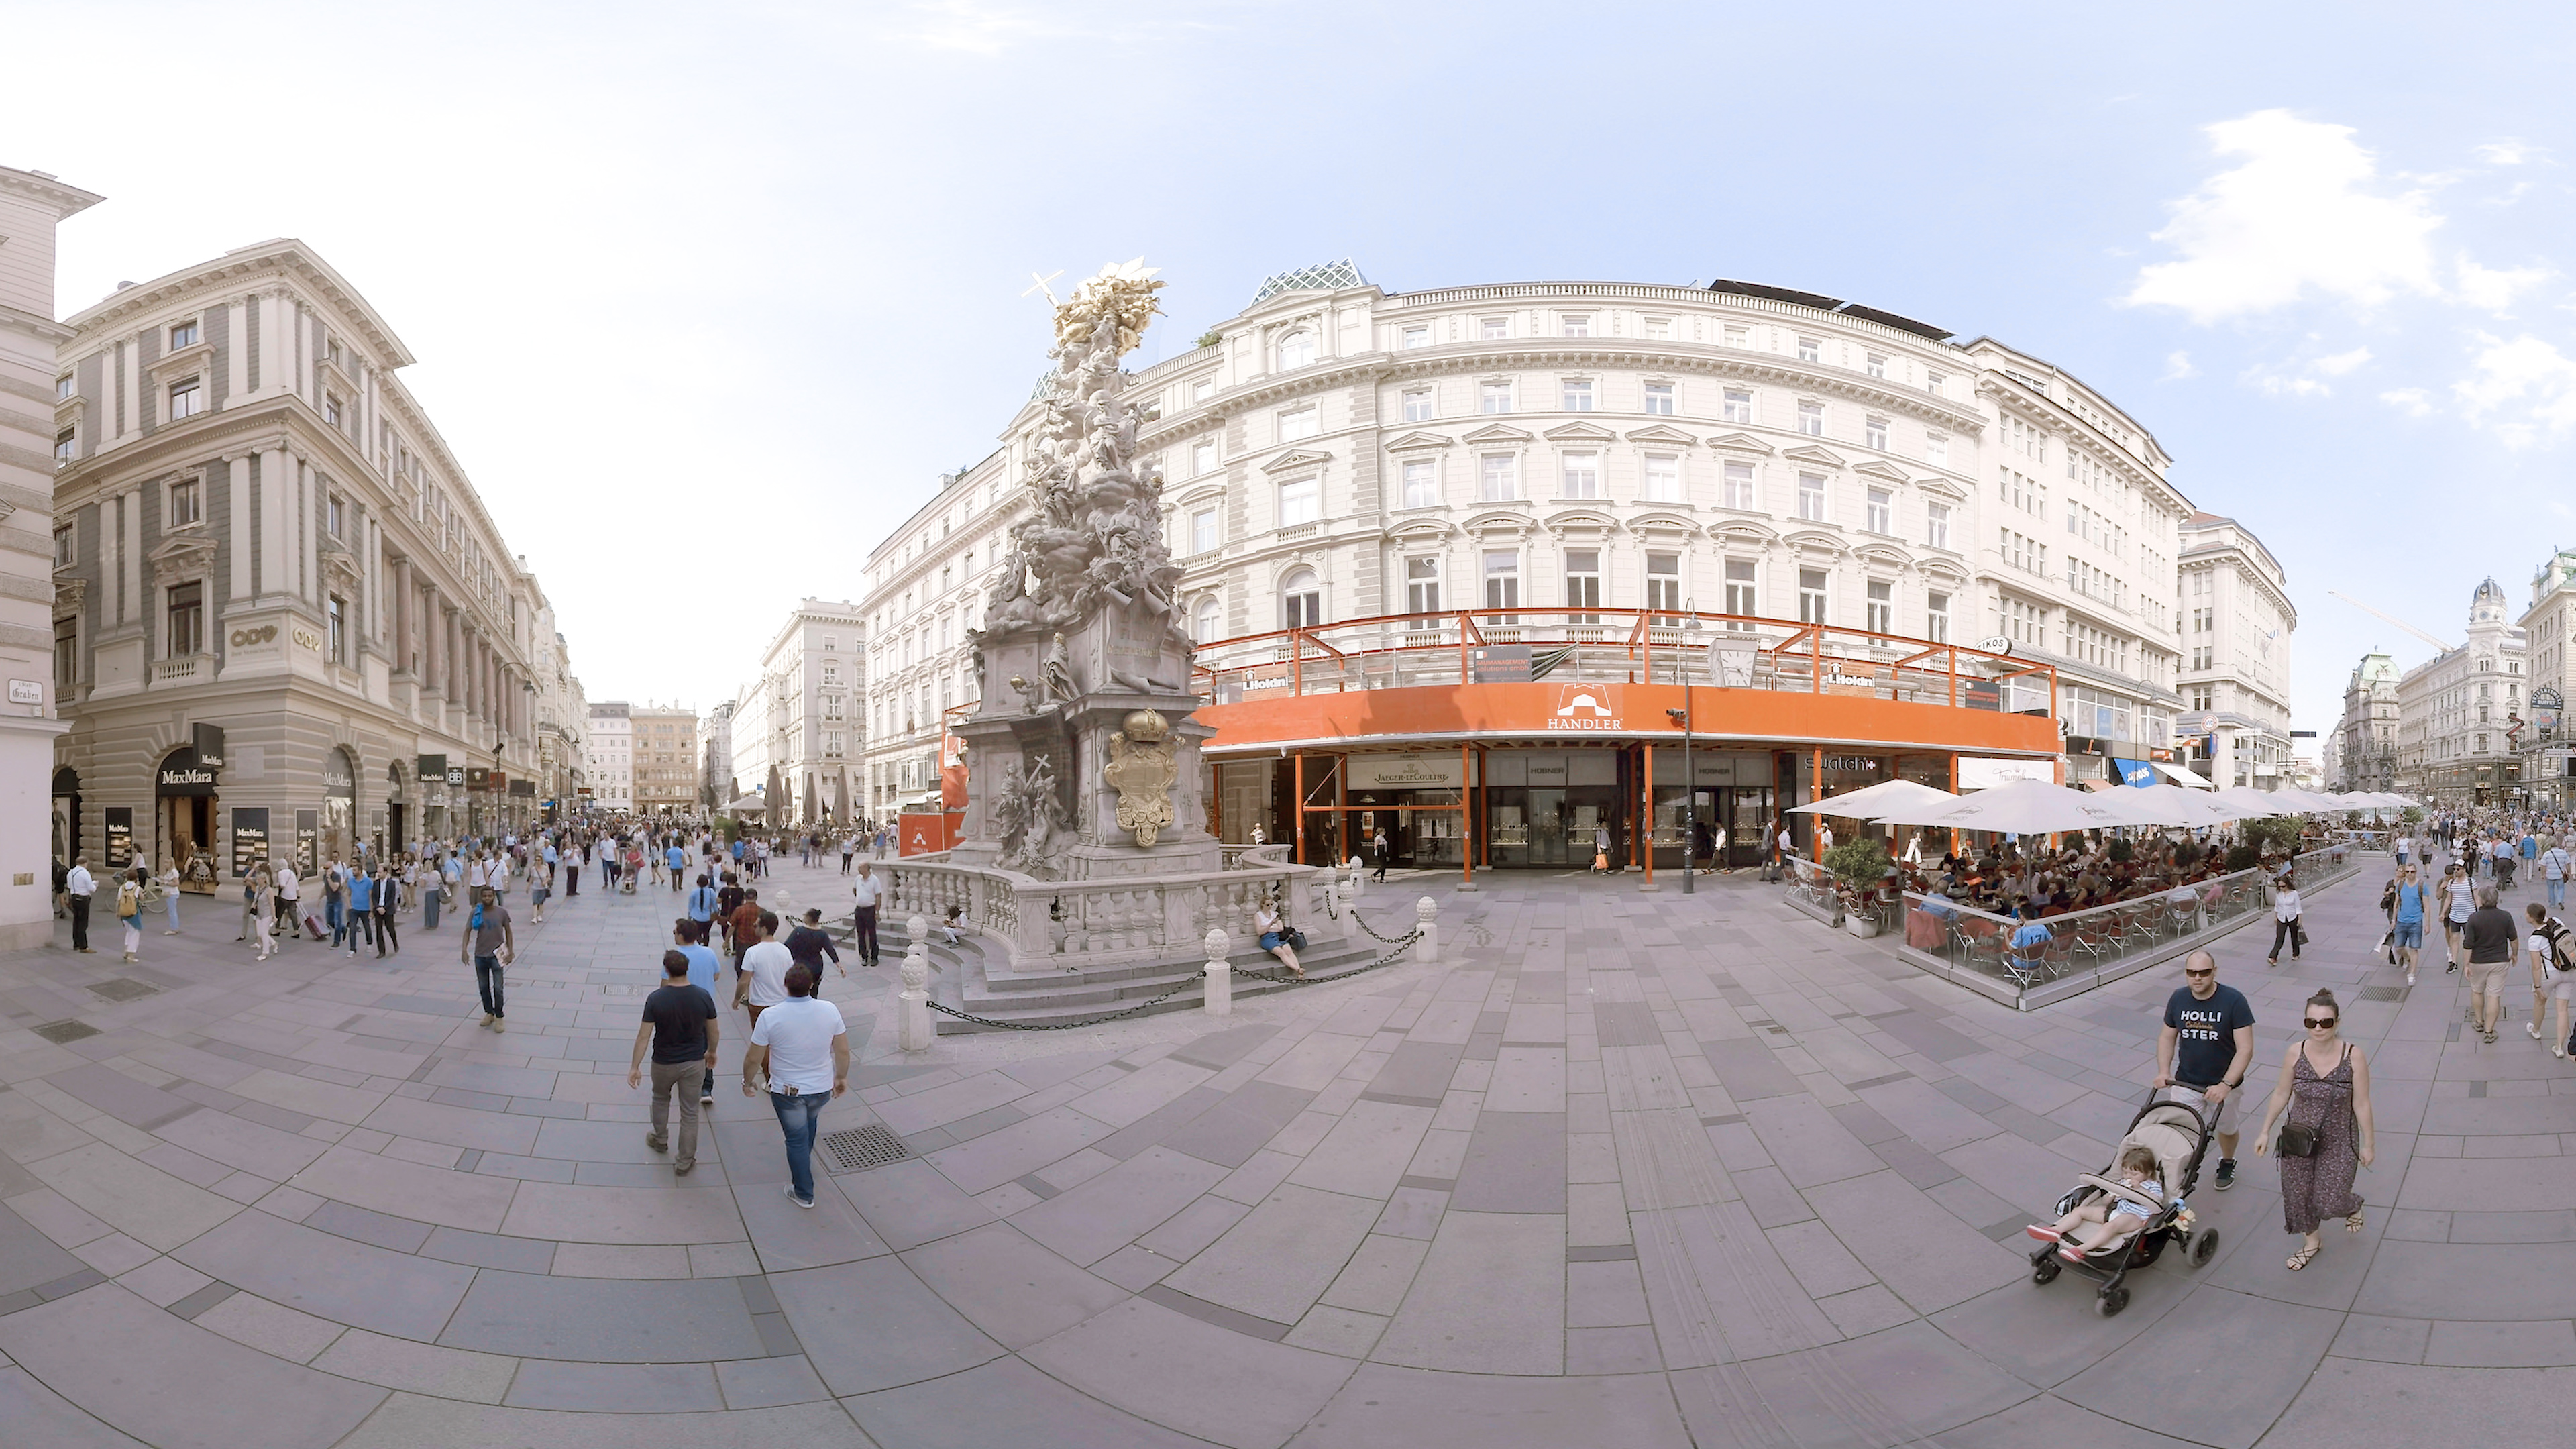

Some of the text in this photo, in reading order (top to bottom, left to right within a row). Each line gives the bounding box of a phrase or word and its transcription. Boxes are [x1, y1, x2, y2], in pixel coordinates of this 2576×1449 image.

[12, 688, 39, 700] Graben
[1547, 718, 1621, 730] HANDLER
[201, 754, 223, 766] MaxMara
[162, 769, 213, 784] MaxMara
[323, 772, 352, 787] MaxMara
[237, 828, 264, 837] MaxMara
[2180, 1010, 2222, 1022] HOLLI
[2181, 1028, 2218, 1040] STER
